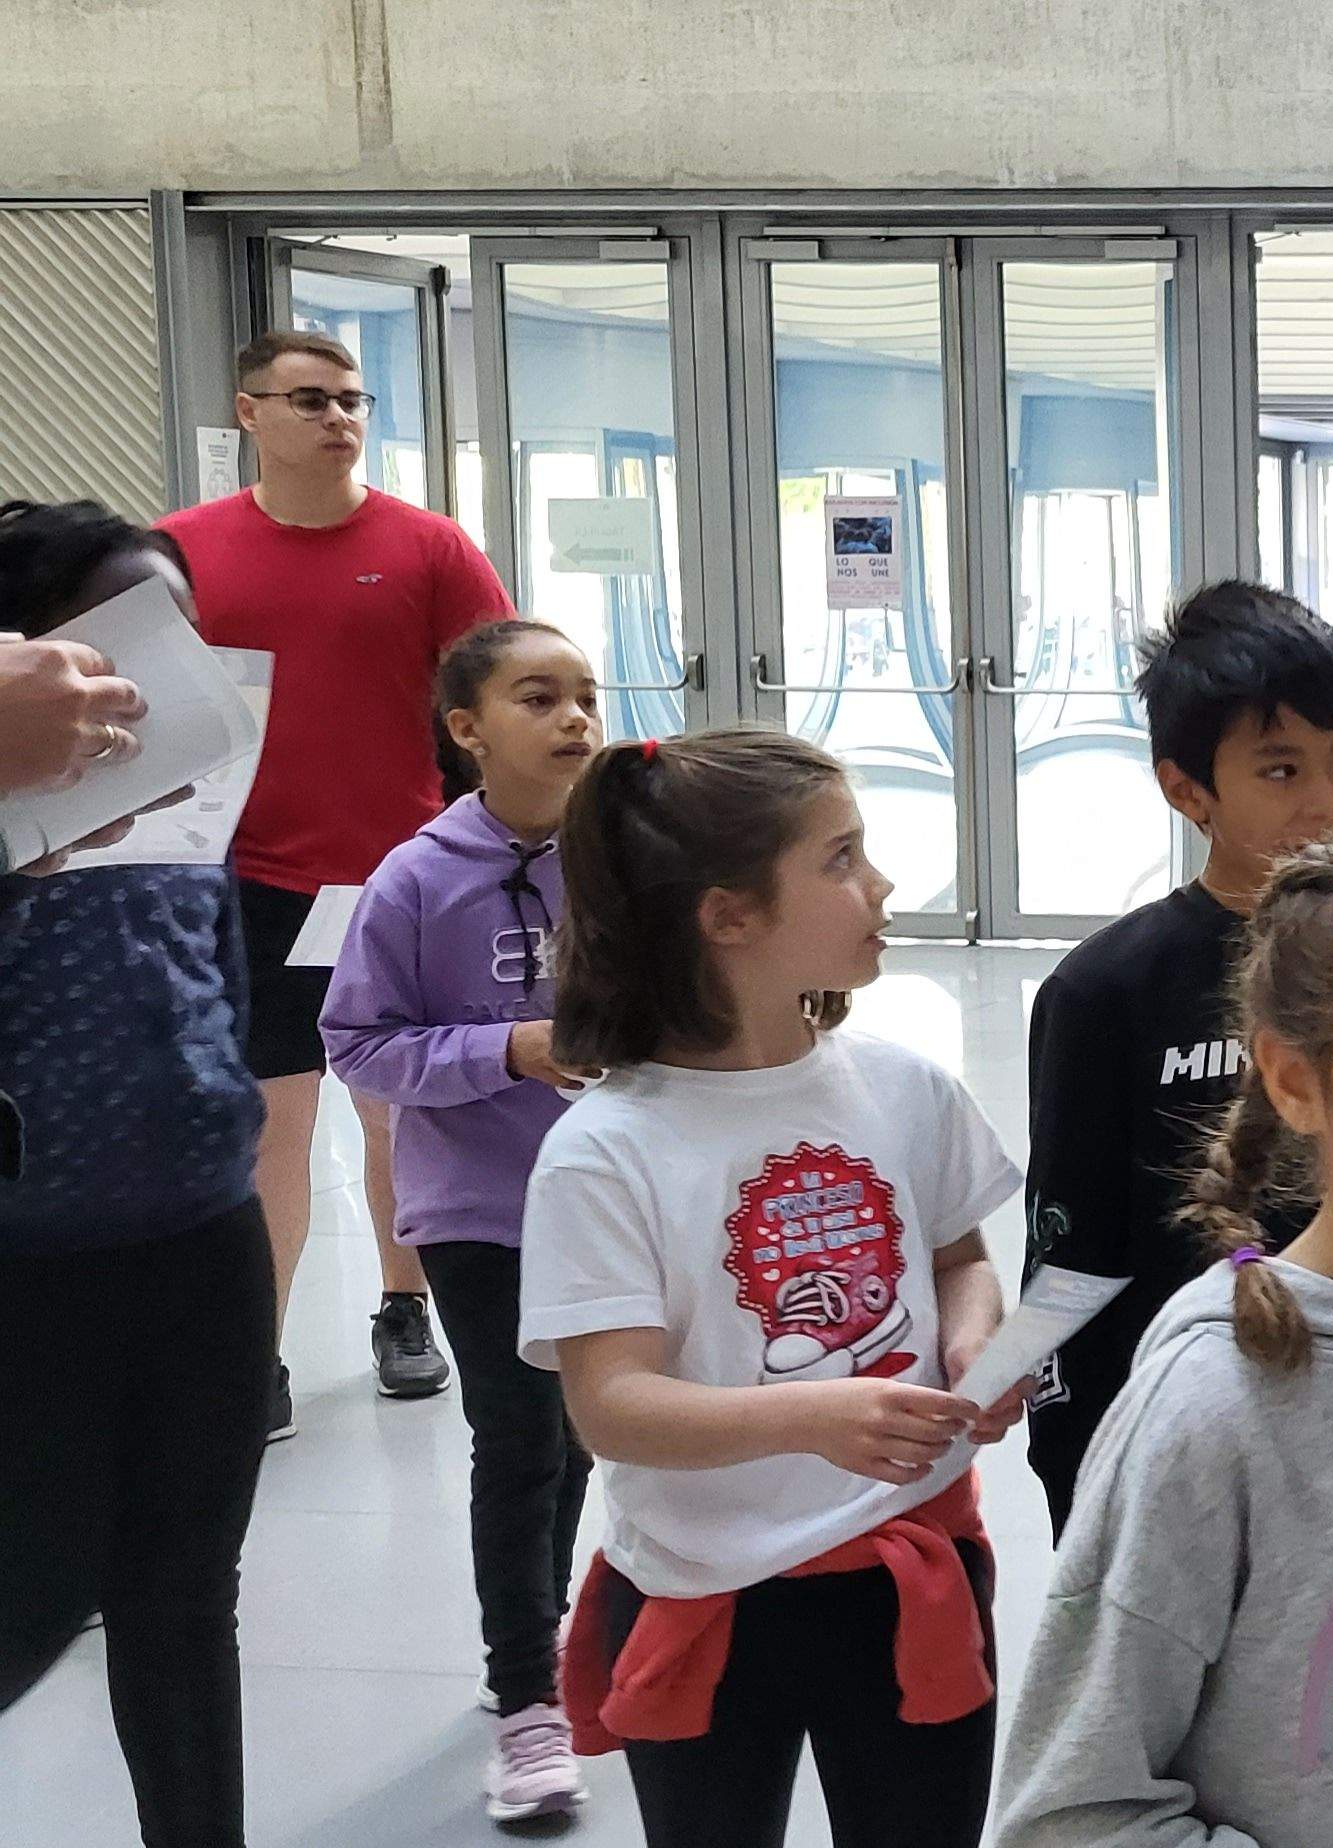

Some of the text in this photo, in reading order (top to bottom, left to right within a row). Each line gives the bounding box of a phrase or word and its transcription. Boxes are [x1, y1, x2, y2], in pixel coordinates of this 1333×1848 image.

[835, 557, 889, 567] LO QUE
[837, 568, 890, 578] NOS UNE
